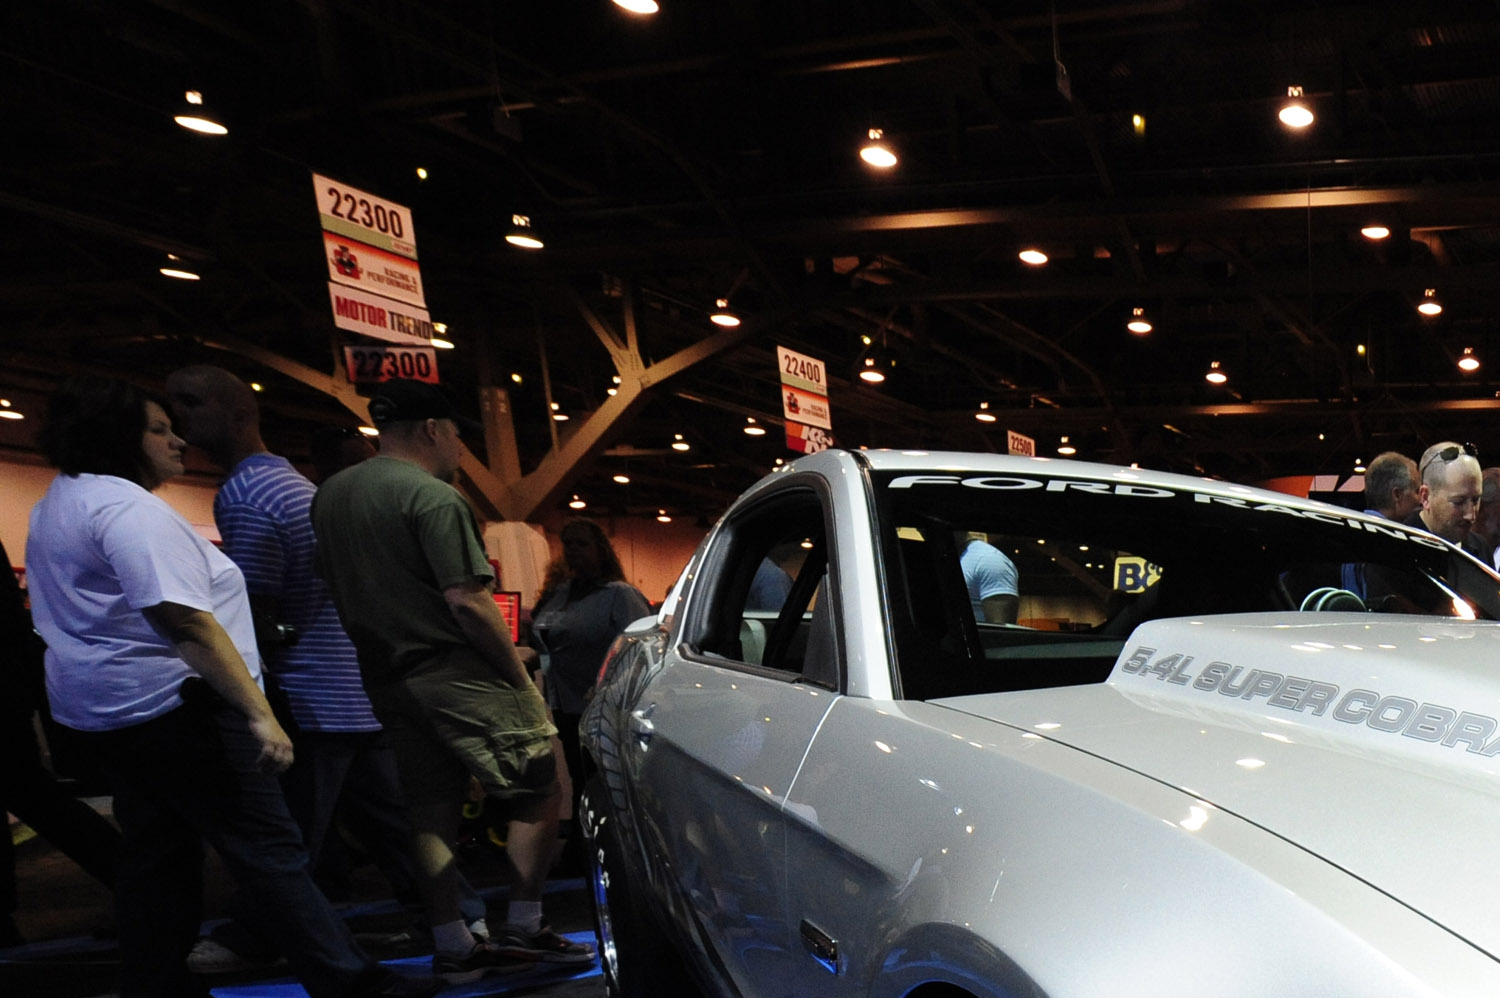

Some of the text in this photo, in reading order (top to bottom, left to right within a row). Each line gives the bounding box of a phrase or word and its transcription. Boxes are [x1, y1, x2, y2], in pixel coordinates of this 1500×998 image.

[328, 187, 404, 239] 22300
[335, 295, 433, 339] MOTOR TREND
[353, 350, 431, 378] 22300
[784, 354, 821, 383] 22400
[888, 475, 1451, 551] FORD RACING
[1121, 646, 1195, 686] 5.4L
[1192, 660, 1341, 717] SUPER
